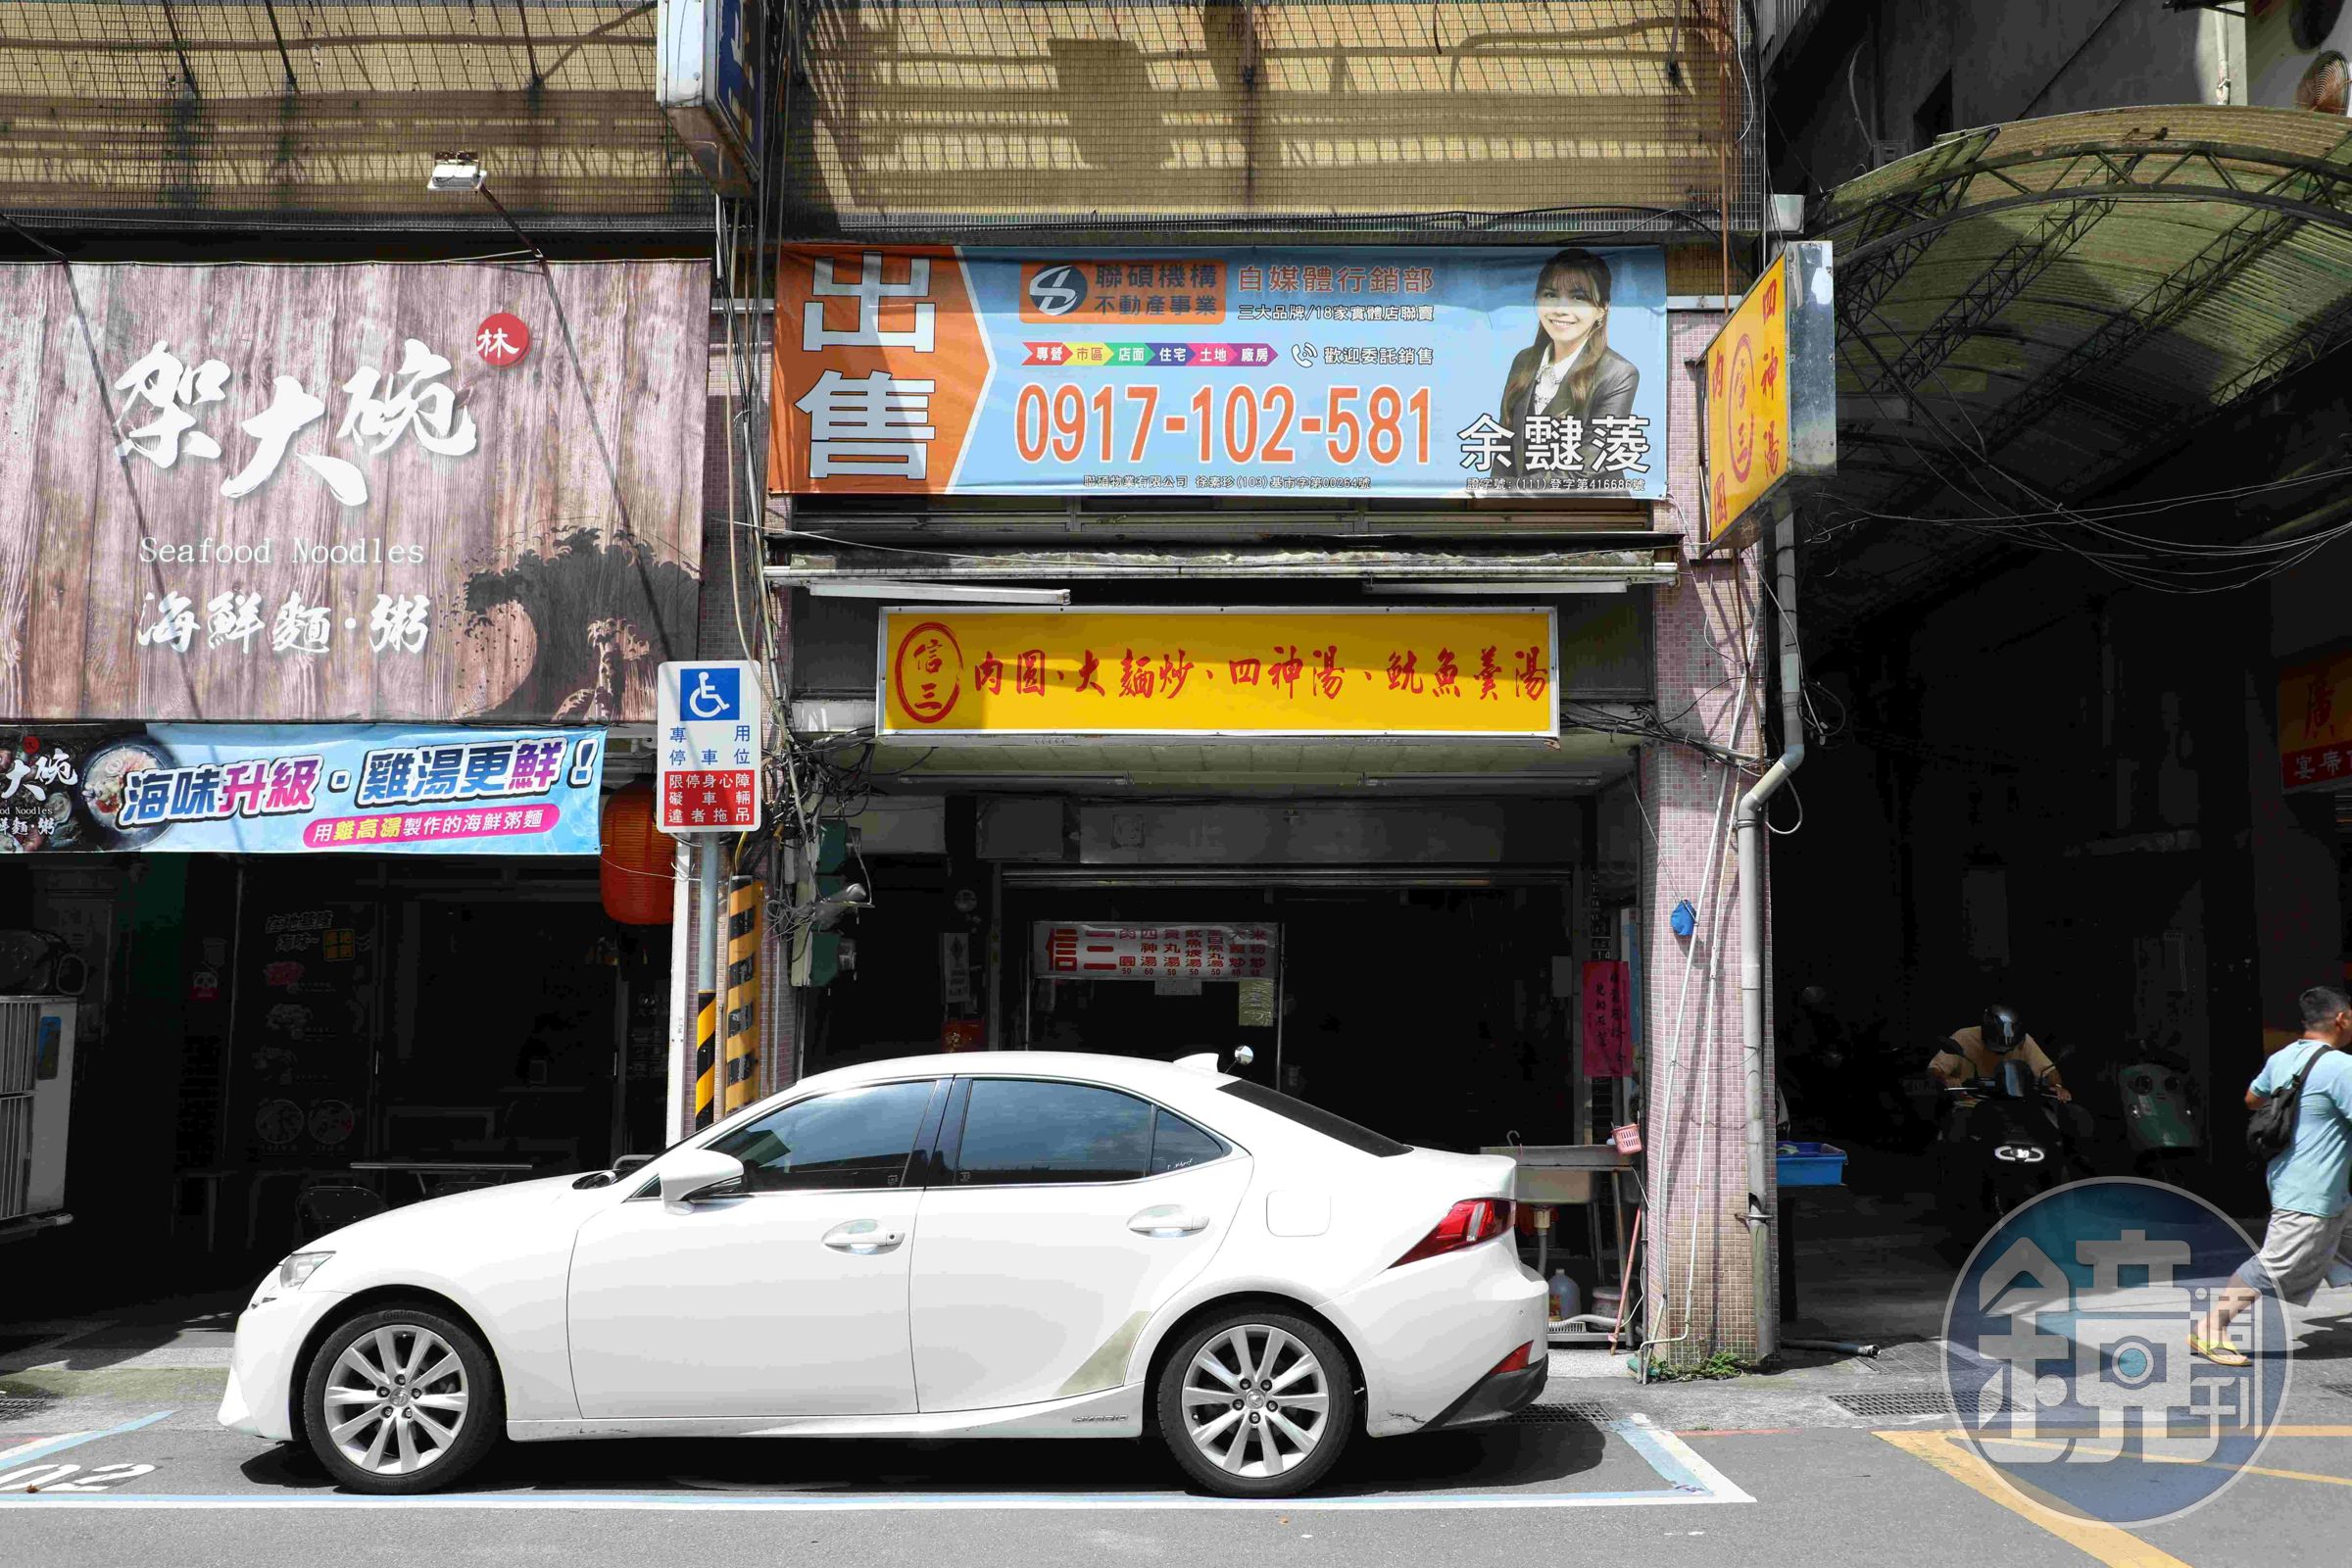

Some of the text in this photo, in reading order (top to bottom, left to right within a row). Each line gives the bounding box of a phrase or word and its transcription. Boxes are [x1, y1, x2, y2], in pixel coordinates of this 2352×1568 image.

[1095, 265, 1218, 289] 聯碩機構
[1239, 266, 1435, 293] 自媒體行銷部
[1094, 295, 1217, 316] 不動產事業
[476, 326, 520, 360] 林
[1036, 346, 1269, 364] 專營 市區 店面 住宅 土地 廠房
[795, 251, 936, 480] 出售
[1323, 346, 1434, 366] 歡迎委託銷售
[1761, 278, 1780, 478] 四神湯
[114, 338, 478, 508] 架大碗
[1014, 382, 1432, 466] 0917-102-581
[1712, 349, 1727, 525] 肉圓
[1083, 474, 1189, 489] 聯碩物業有限公司
[139, 536, 425, 565] Seafood Noodles
[913, 639, 943, 710] 信三
[669, 724, 751, 744] 專用
[668, 748, 751, 766] 停車位
[668, 772, 751, 790] 限停身心障
[15, 806, 53, 815] Noodles
[668, 790, 751, 807] 礙車輛
[313, 808, 544, 844] 用雞高湯製作的海鮮粥麵
[668, 808, 751, 824] 違者拖吊
[1046, 928, 1117, 971] 信三
